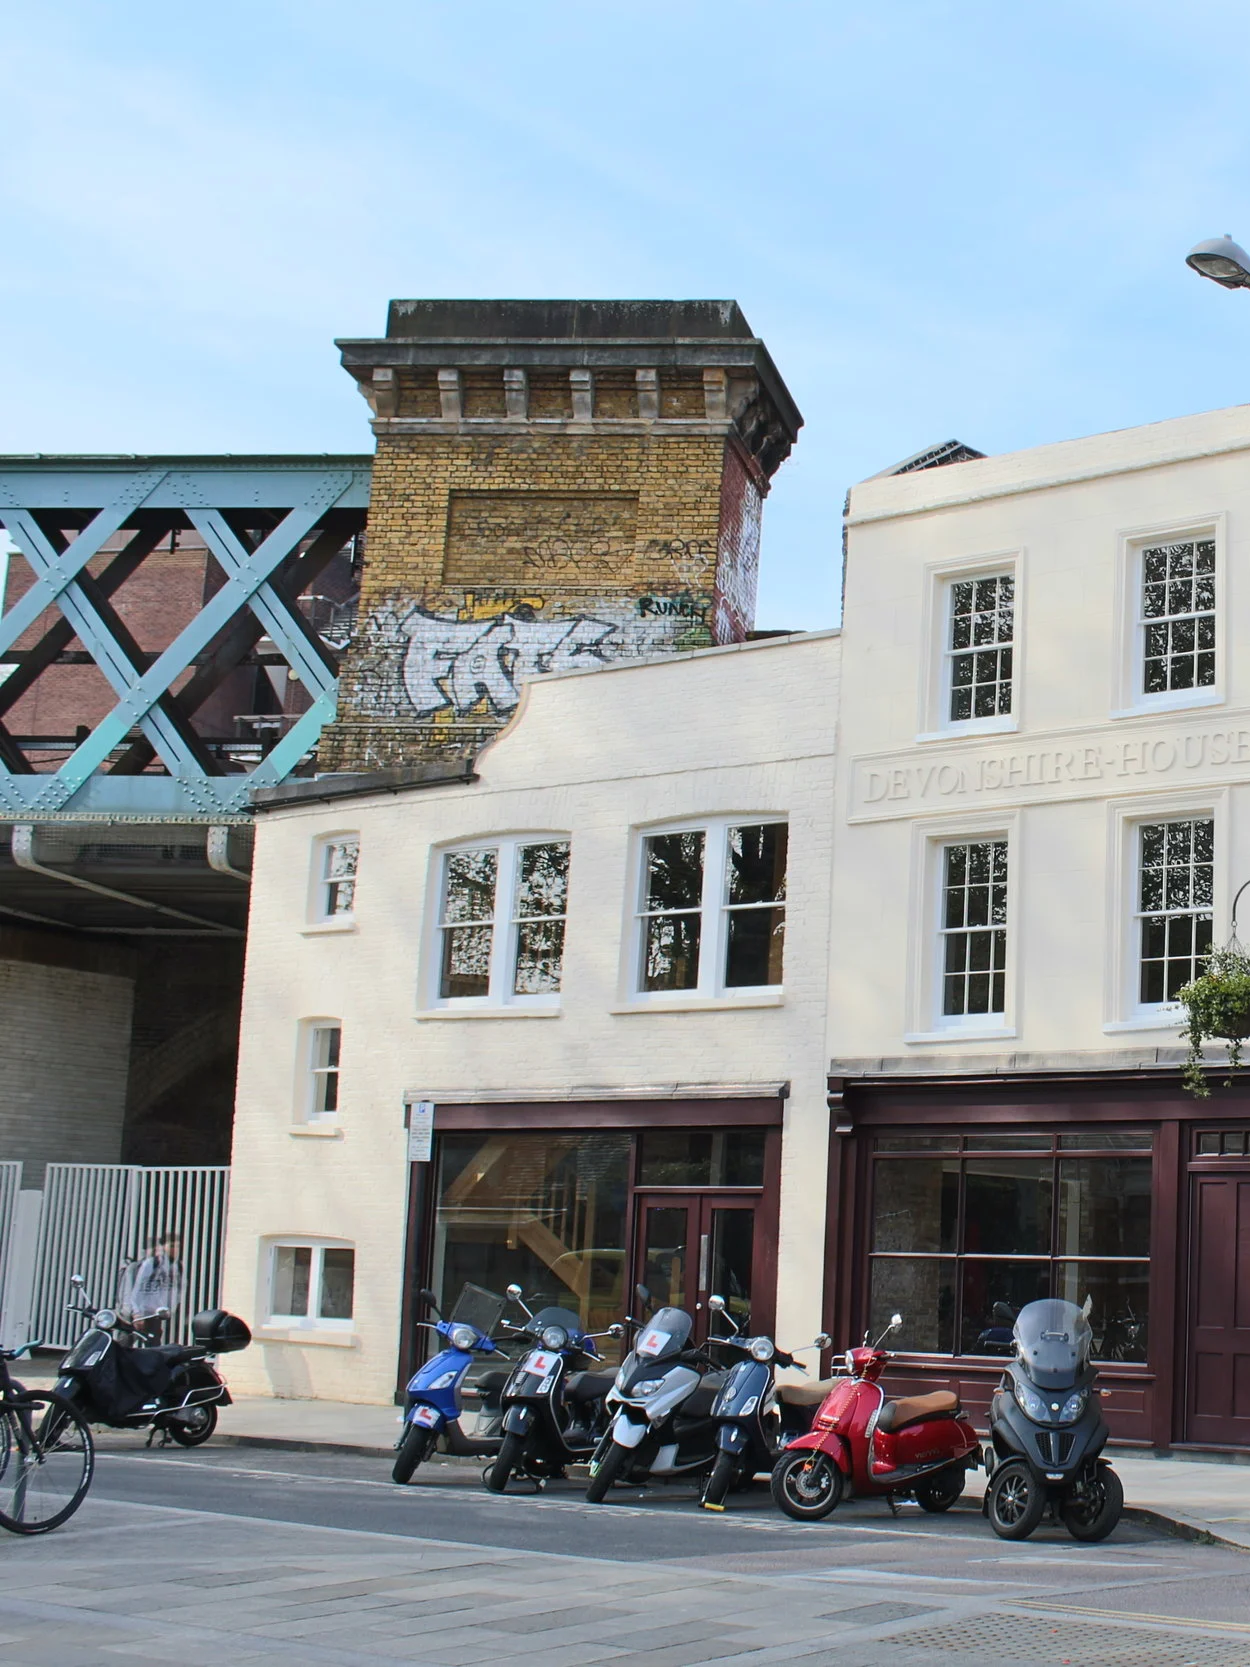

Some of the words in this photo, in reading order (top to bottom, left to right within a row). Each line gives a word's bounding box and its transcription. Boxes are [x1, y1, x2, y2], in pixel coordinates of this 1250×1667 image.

[647, 1334, 658, 1348] L
[534, 1356, 547, 1370] L
[419, 1408, 433, 1420] L
